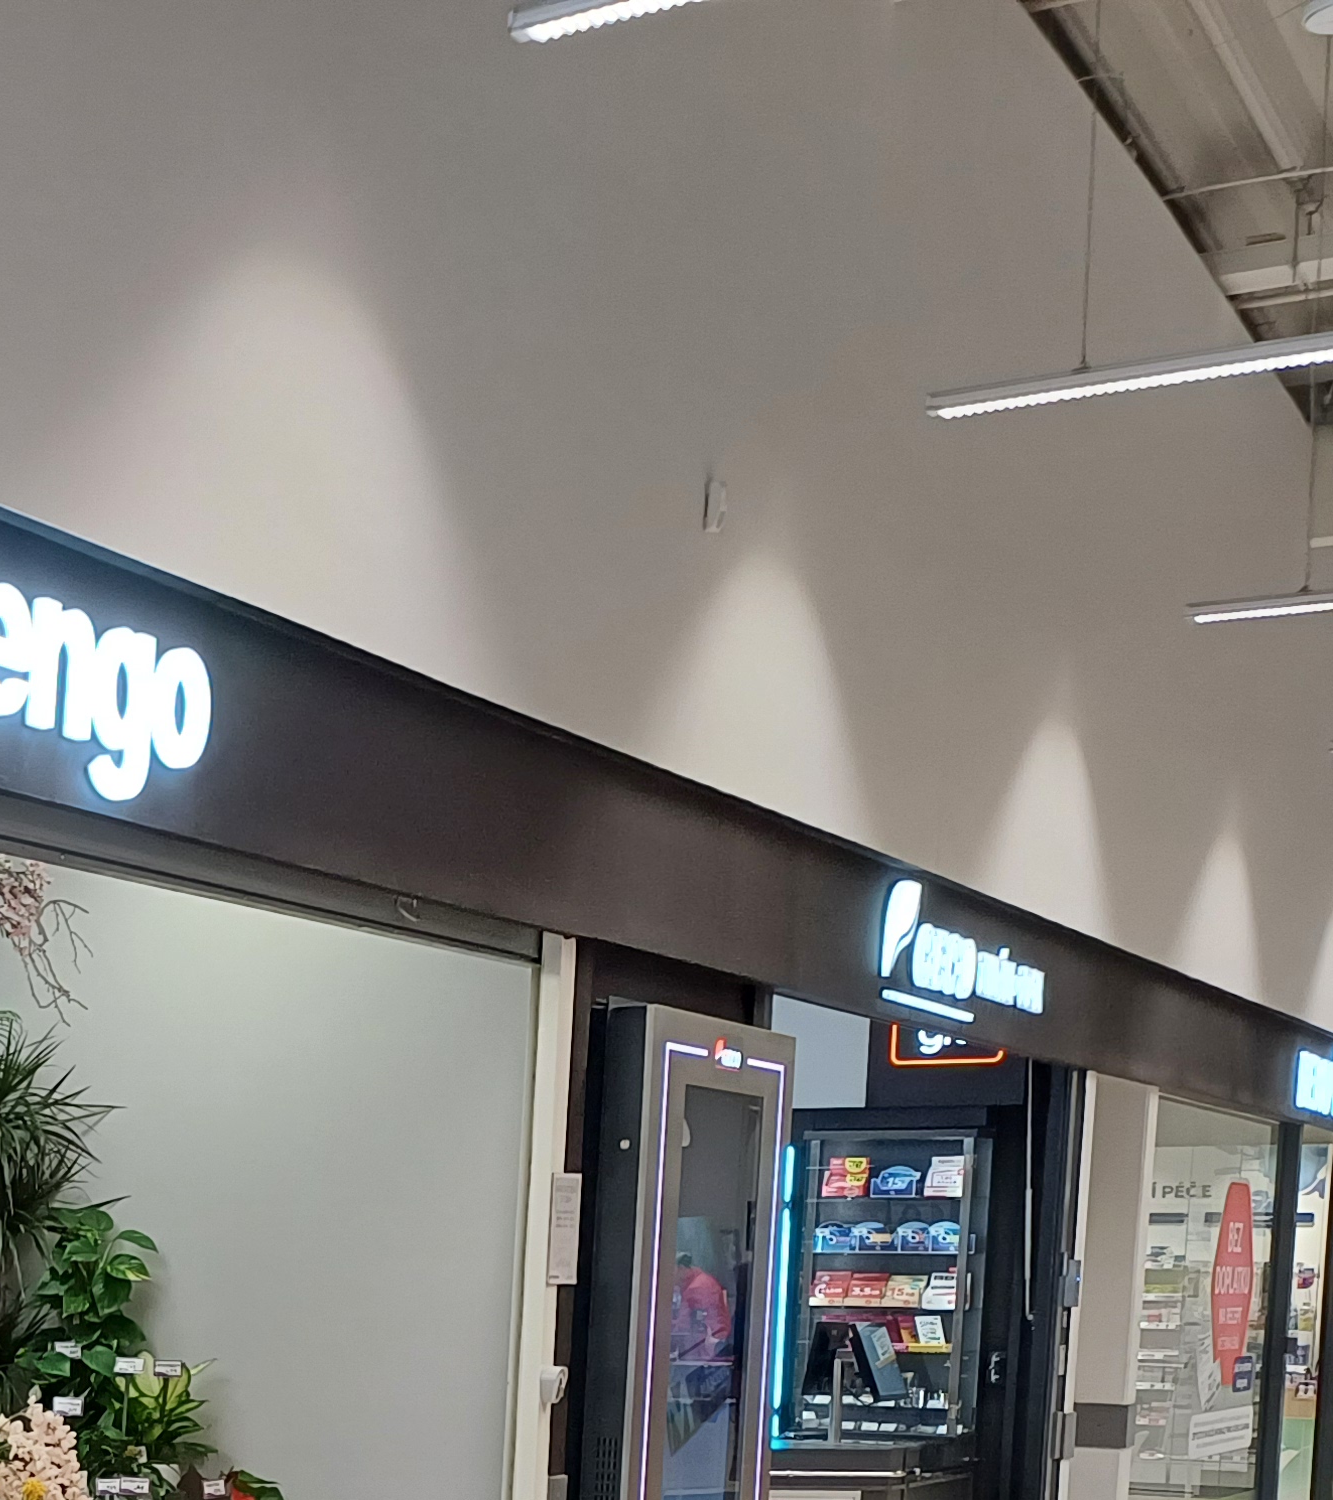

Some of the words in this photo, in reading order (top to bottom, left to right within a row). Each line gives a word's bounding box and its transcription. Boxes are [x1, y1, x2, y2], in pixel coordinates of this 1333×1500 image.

[1161, 1181, 1212, 1199] PÉČE
[1228, 1222, 1244, 1253] BEZ
[1214, 1265, 1251, 1294] DOPLATKU
